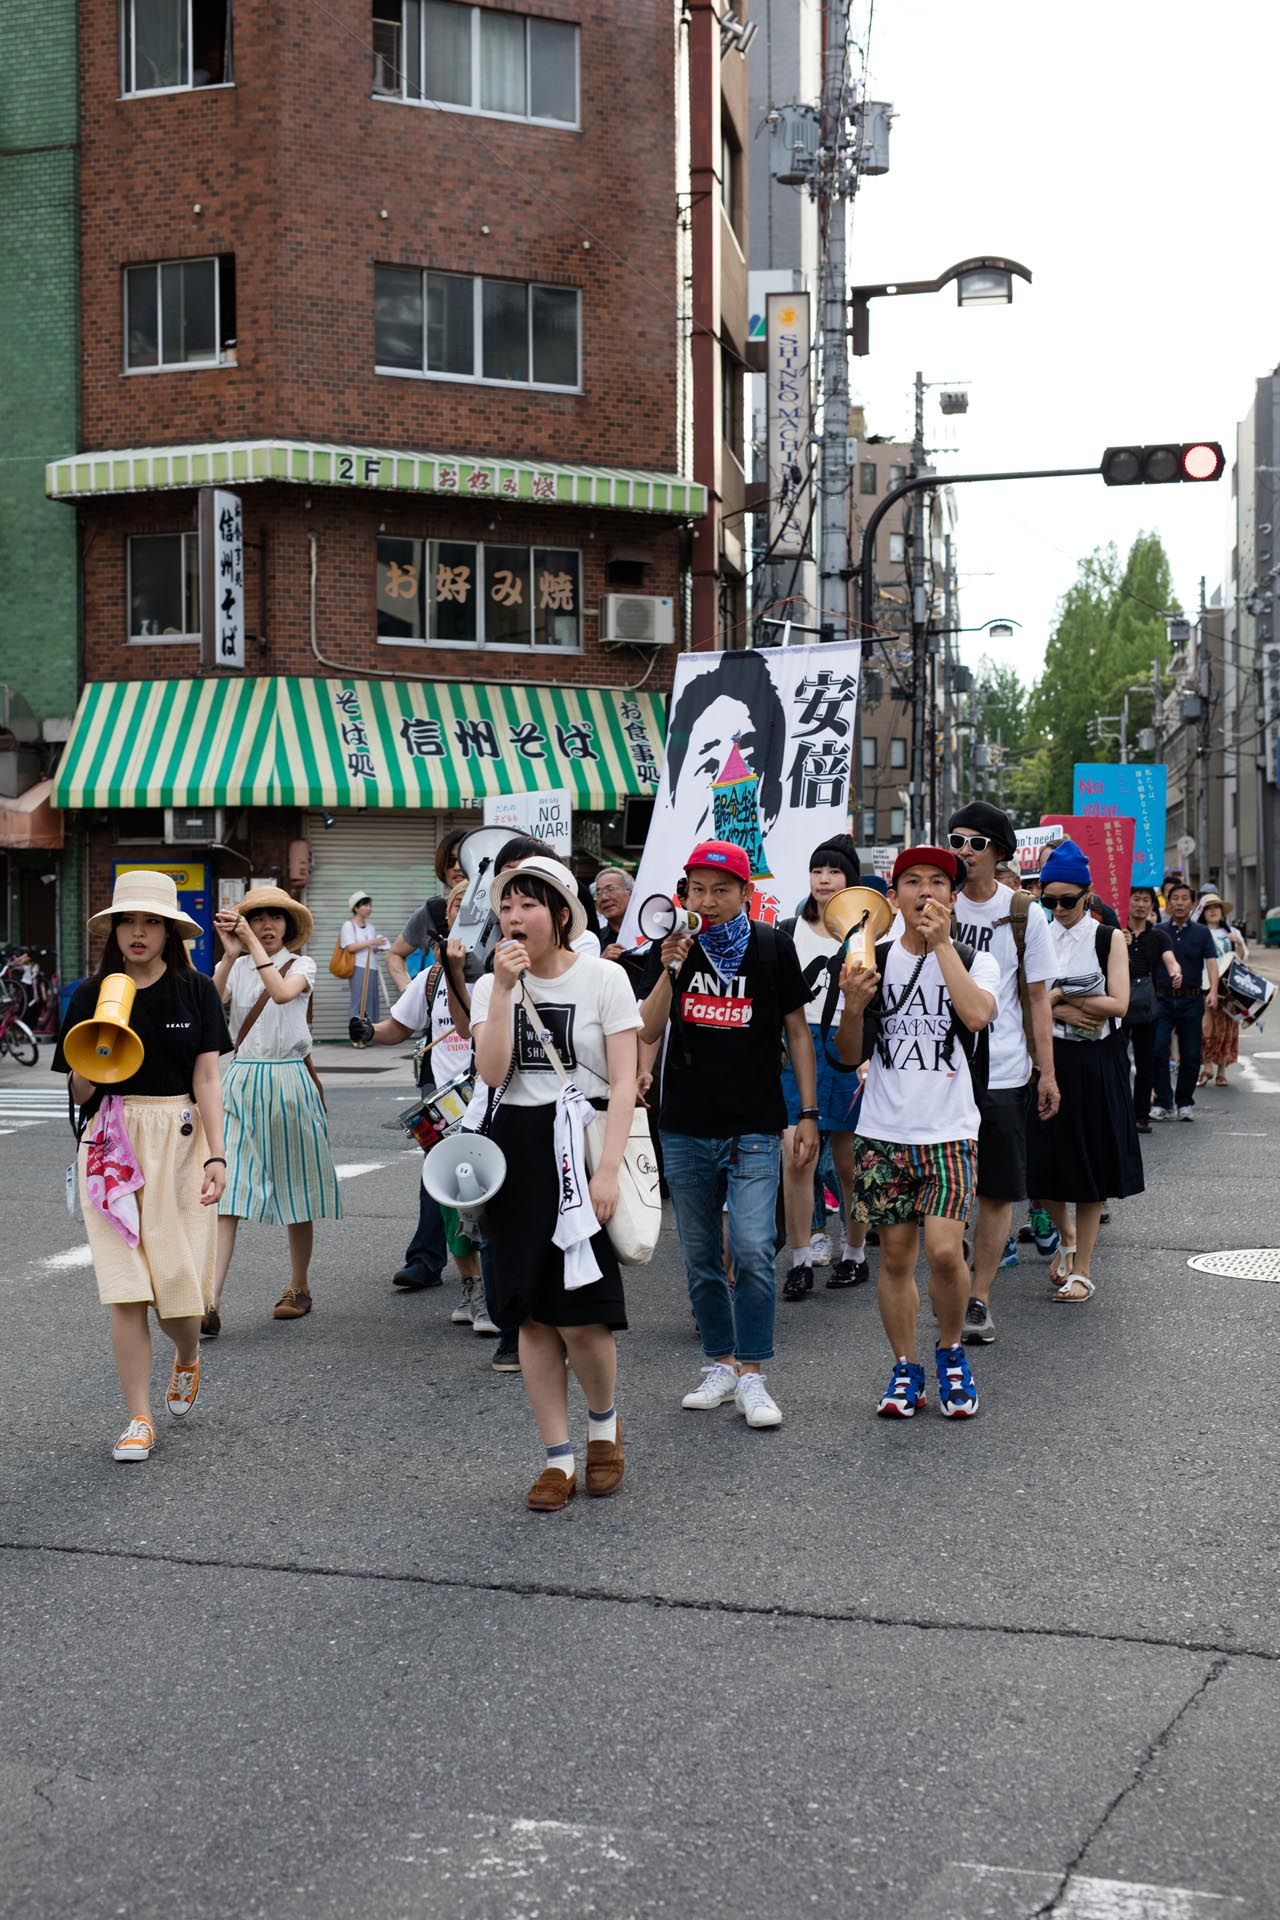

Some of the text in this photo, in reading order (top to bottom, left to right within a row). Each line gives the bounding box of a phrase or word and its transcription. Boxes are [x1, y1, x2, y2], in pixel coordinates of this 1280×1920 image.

[778, 334, 799, 402] SHINKO
[439, 468, 556, 498] お好み焼
[219, 507, 237, 657] 信州そば
[383, 560, 575, 612] お好み焼
[335, 688, 376, 779] そば処
[400, 717, 599, 761] 信州そば
[619, 701, 661, 785] お食事処
[789, 669, 859, 809] 安倍
[1078, 778, 1105, 797] No
[530, 821, 568, 838] WAR!
[539, 805, 560, 822] NO
[1016, 836, 1032, 847] on't
[687, 971, 747, 999] ANTI
